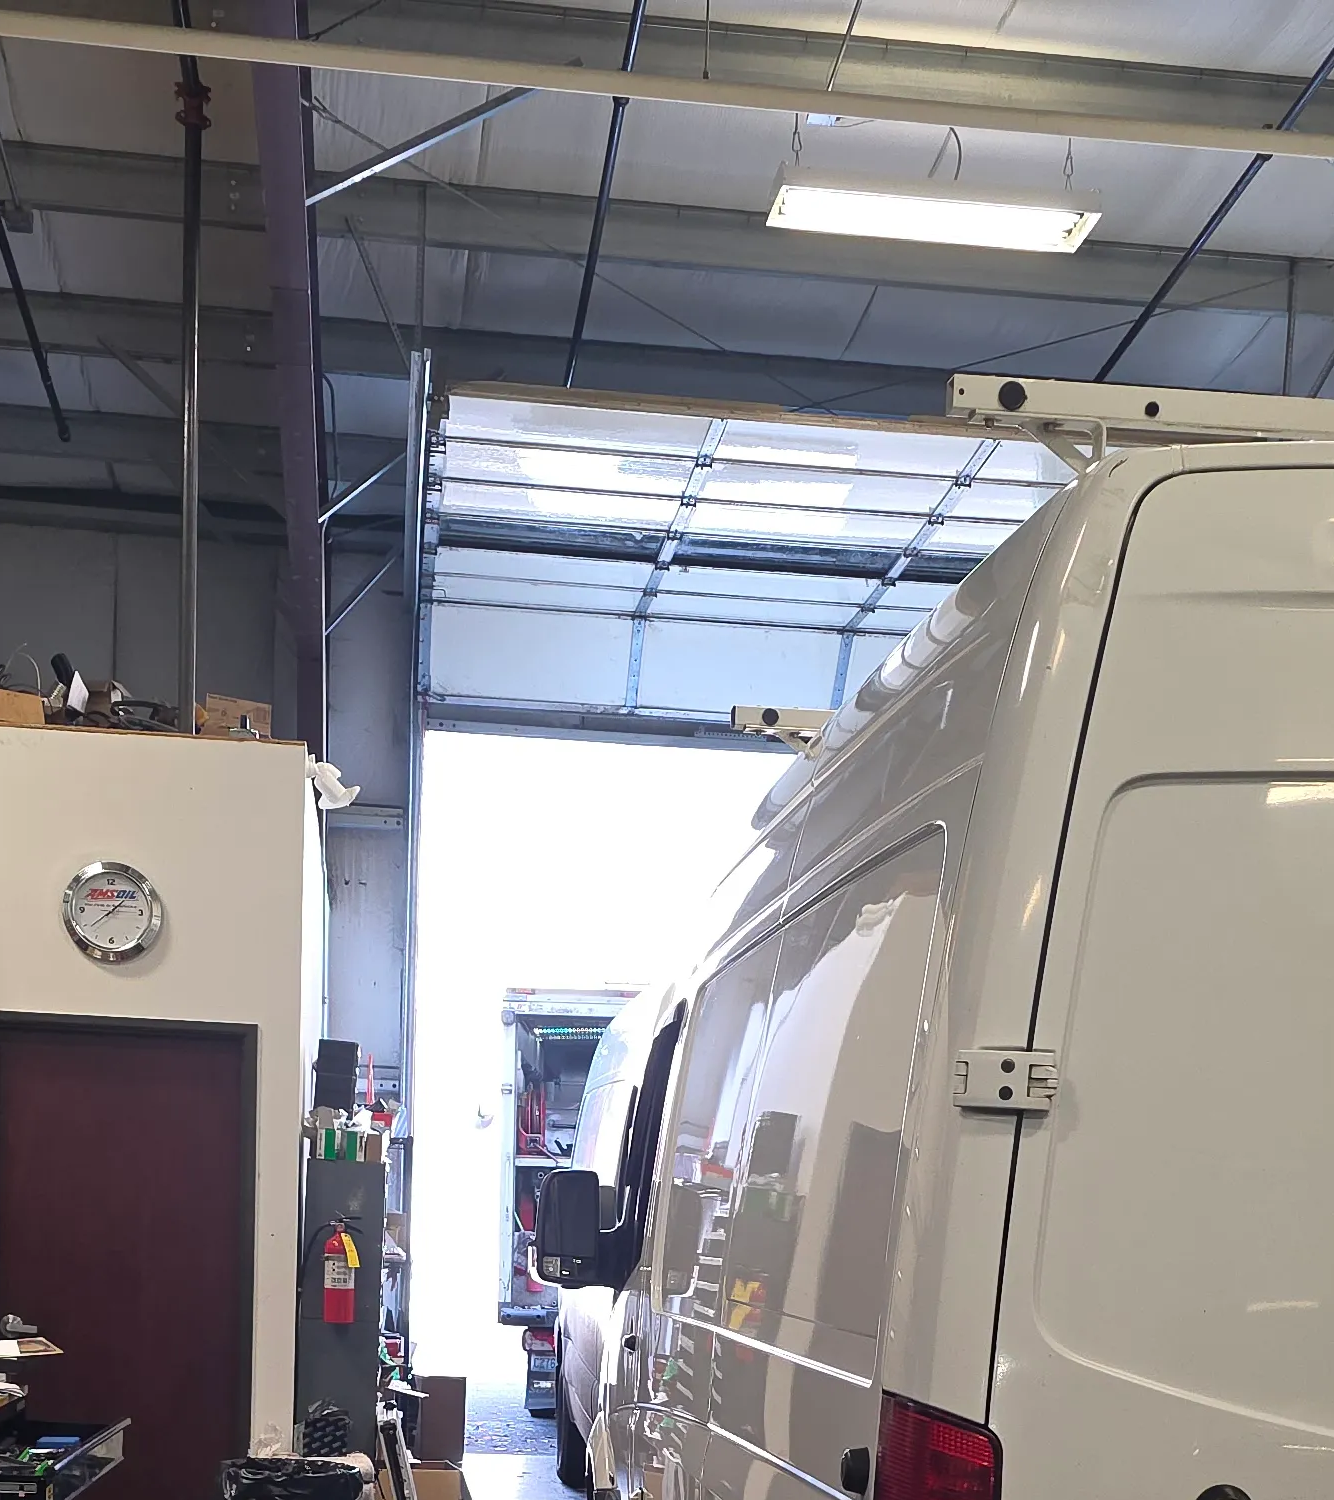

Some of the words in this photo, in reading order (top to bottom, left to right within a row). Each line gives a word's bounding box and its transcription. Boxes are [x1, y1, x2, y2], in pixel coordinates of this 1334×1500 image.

[107, 878, 116, 886] 12
[84, 888, 139, 900] AMSOIL
[78, 906, 85, 914] 9
[108, 936, 115, 945] 6
